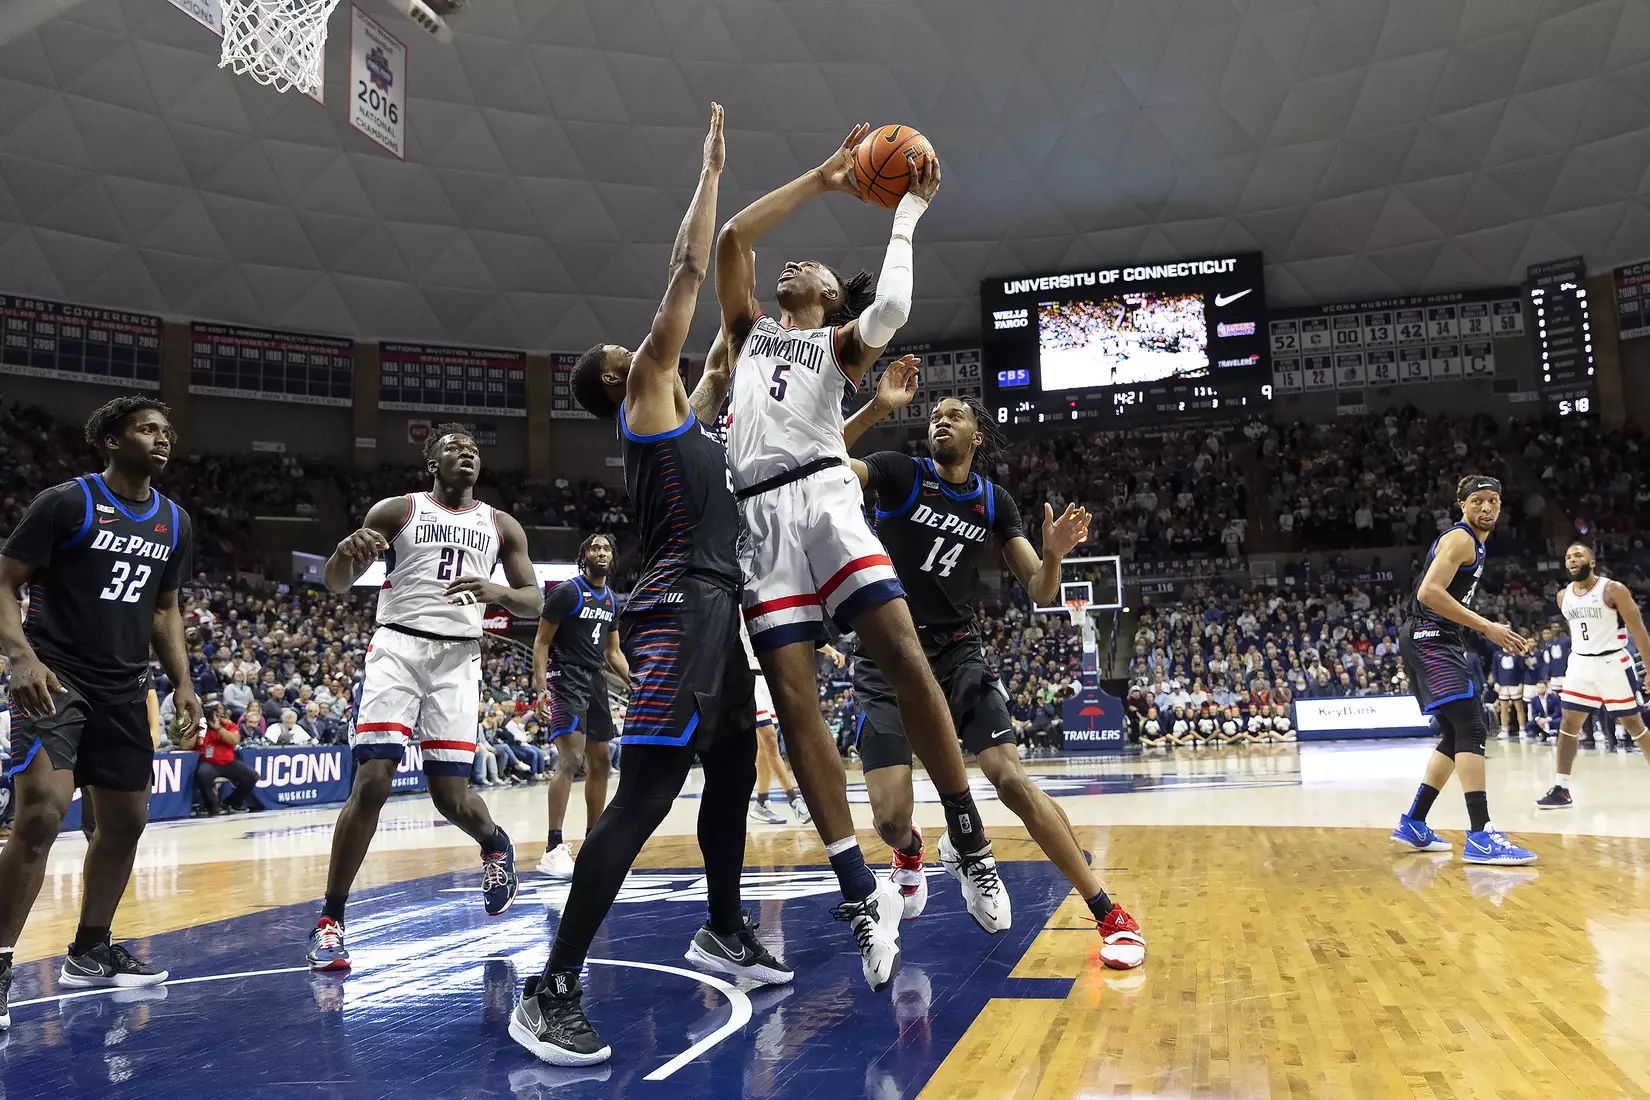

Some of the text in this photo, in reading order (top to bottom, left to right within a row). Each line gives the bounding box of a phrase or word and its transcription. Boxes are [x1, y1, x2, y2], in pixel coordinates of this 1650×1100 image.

[358, 80, 398, 124] 2016
[359, 105, 396, 138] NATIONAL
[356, 117, 399, 153] CHAMPIONS
[1004, 258, 1237, 295] UNIVERSITY OF CONNECTICUT
[1322, 303, 1356, 313] UCONN
[1361, 297, 1405, 309] HUSKIES
[1427, 293, 1463, 302] HONOR
[62, 306, 158, 326] CONFERENCE
[992, 309, 1028, 321] WELLS
[993, 318, 1028, 329] FARGO
[1400, 324, 1422, 338] 42
[1436, 322, 1450, 335] 34
[1274, 335, 1295, 349] 52
[1337, 330, 1358, 344] 00
[1370, 327, 1388, 341] 13
[749, 334, 825, 374] CONNECTICUT
[900, 344, 931, 352] HONOR
[1217, 357, 1254, 368] TRAVELERS
[1408, 362, 1421, 376] 13
[1471, 355, 1486, 372] C
[959, 364, 979, 378] 42
[998, 369, 1025, 381] CBS
[1312, 370, 1325, 384] 22
[769, 364, 791, 402] 5
[1282, 373, 1294, 387] 15
[1113, 391, 1143, 405] 14:21
[1261, 384, 1272, 401] 9
[907, 405, 921, 418] 13
[1559, 397, 1590, 415] 5:18
[998, 407, 1008, 423] 8
[910, 503, 986, 542] DEPAUL
[90, 528, 170, 562] DEPAUL
[414, 524, 491, 555] CONNECTICUT
[437, 547, 466, 580] 21
[920, 536, 964, 578] 14
[99, 560, 152, 603] 32
[659, 592, 685, 603] AUL
[579, 606, 613, 622] DEPAUL
[591, 622, 602, 645] 4
[1580, 622, 1589, 641] 2
[1318, 706, 1377, 718] KeyBank
[1063, 730, 1121, 741] TRAVELERS
[255, 752, 341, 789] UCONN
[278, 788, 317, 803] HUSKIES
